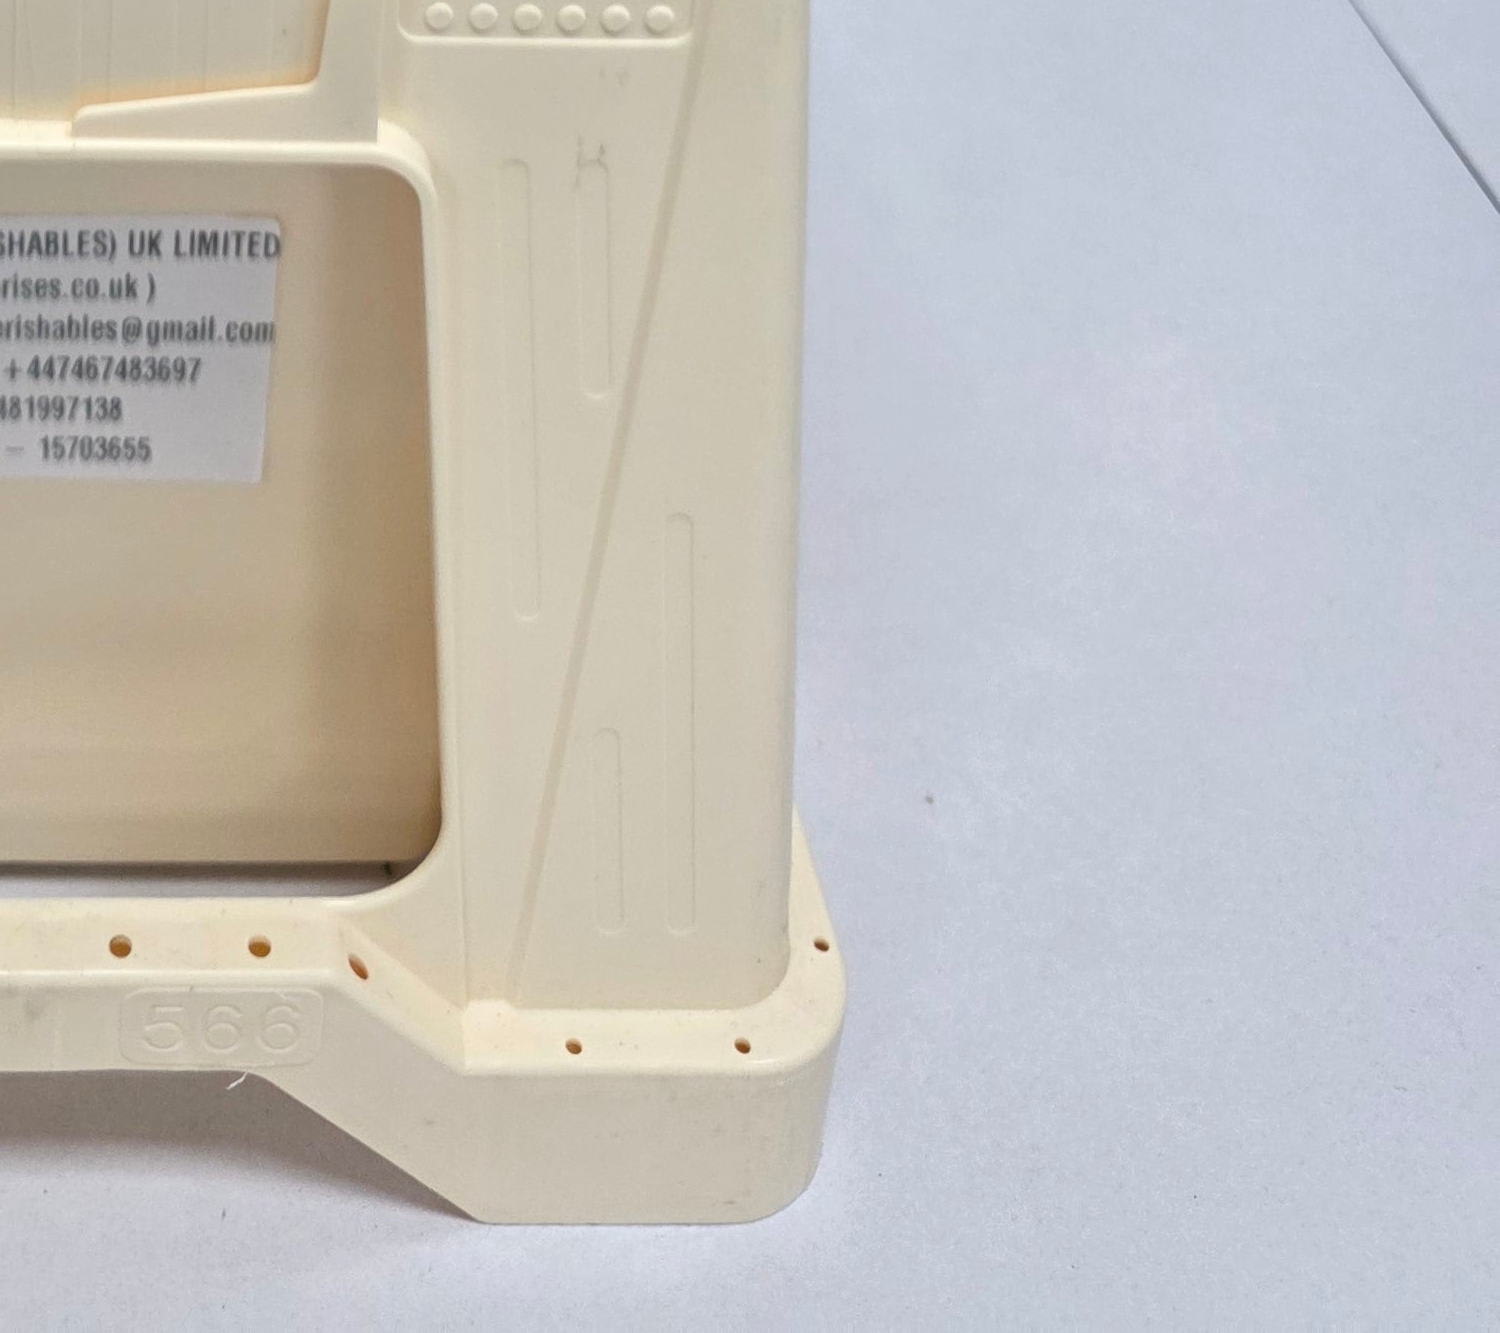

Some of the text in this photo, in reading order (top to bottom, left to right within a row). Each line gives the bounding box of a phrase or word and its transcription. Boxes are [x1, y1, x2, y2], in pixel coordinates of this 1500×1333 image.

[127, 229, 162, 259] UK
[173, 229, 282, 261] LIMITED
[3, 354, 202, 384] +447467483697
[40, 434, 152, 464] 15703655
[143, 1004, 301, 1054] 566
